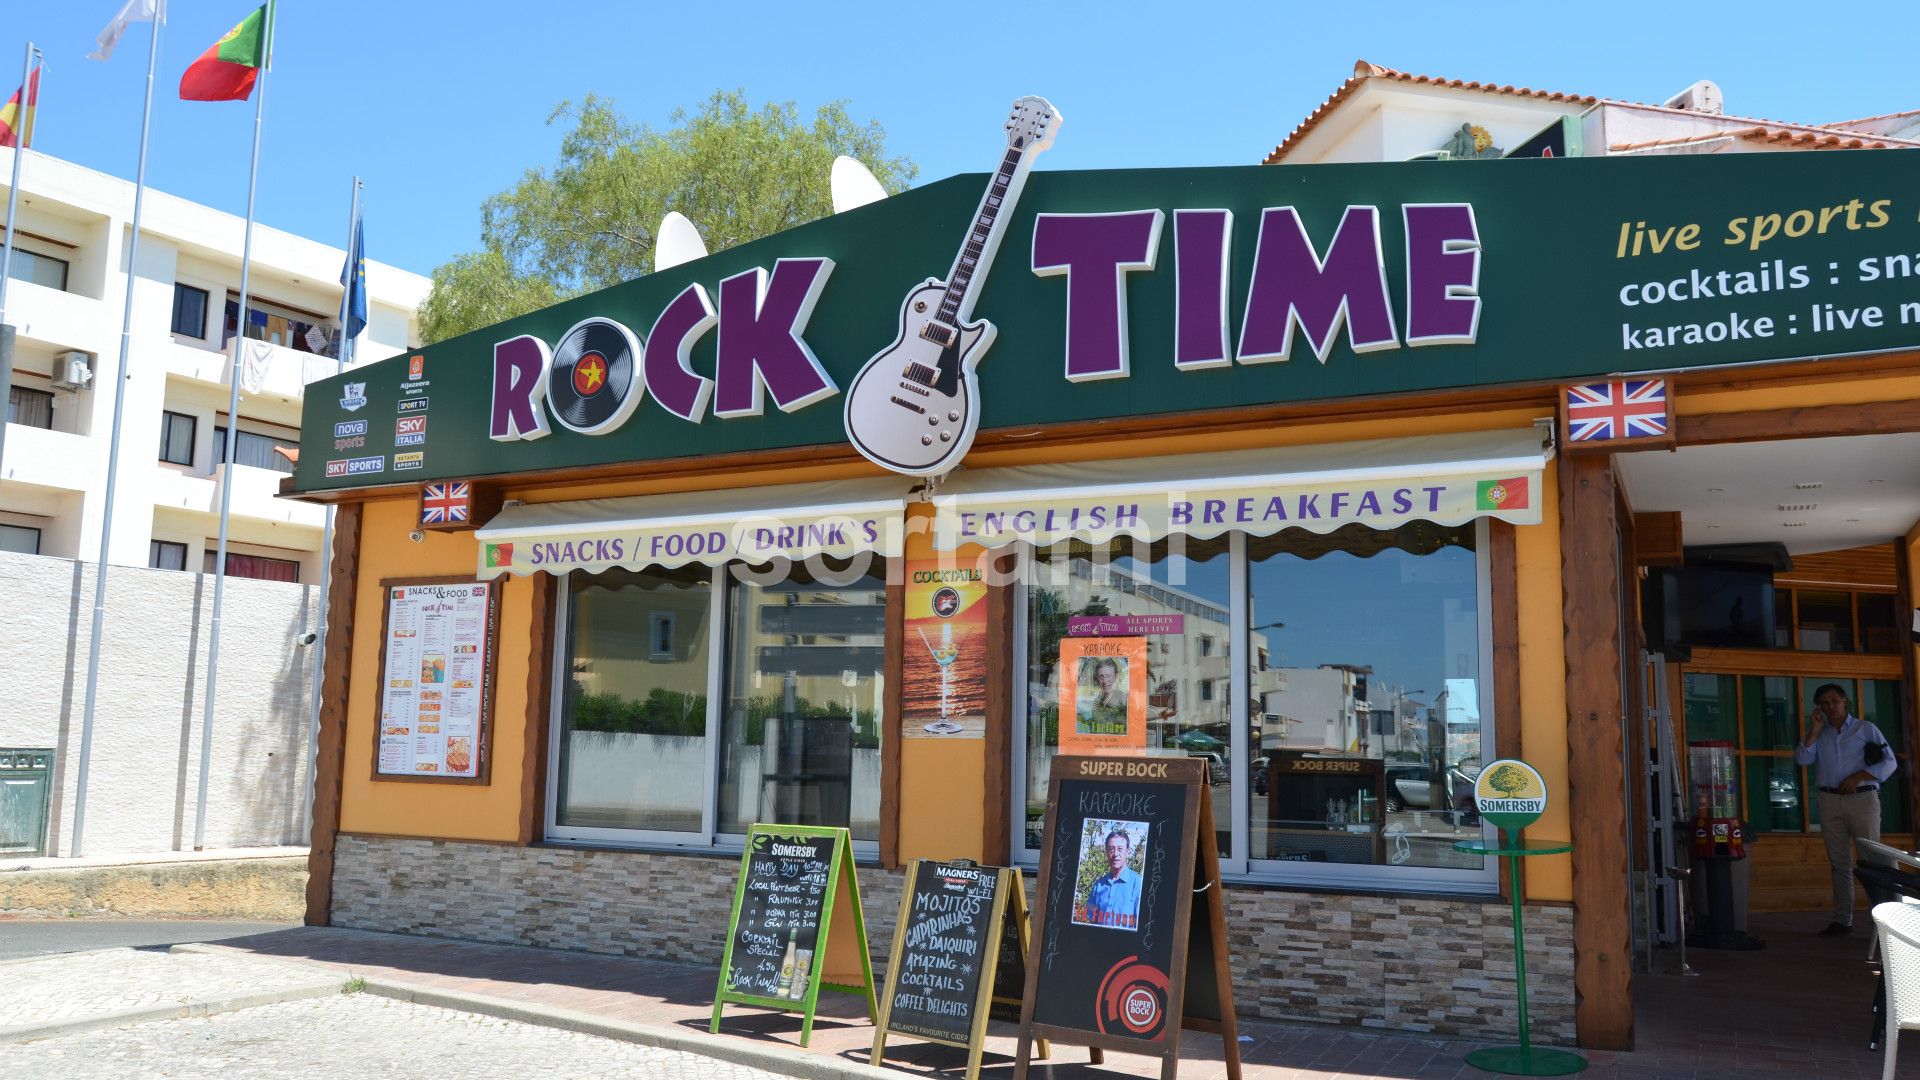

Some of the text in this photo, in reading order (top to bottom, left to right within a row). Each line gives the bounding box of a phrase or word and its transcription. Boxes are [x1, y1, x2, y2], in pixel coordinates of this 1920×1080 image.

[1616, 199, 1892, 258] live sports
[1619, 259, 1811, 306] cocktails
[1858, 250, 1920, 282] sn
[489, 203, 1482, 443] ROCK TIME
[1622, 312, 1775, 350] karaoke
[1812, 303, 1884, 332] live
[418, 400, 426, 408] TV
[338, 423, 364, 434] nova
[399, 418, 423, 432] SKY
[335, 436, 365, 451] sports
[397, 435, 423, 444] ITALIA
[328, 459, 382, 474] SKY SPORTS
[960, 485, 1447, 537] ENGLISH BREAKFAST
[530, 537, 625, 565] SNACKS
[650, 531, 727, 558] FOOD
[912, 567, 983, 584] COCKTAILS
[408, 586, 437, 596] SNACKS
[446, 588, 468, 598] FOOD
[1143, 616, 1173, 624] SPORTS
[1083, 643, 1123, 656] KARAOKE
[1079, 760, 1168, 778] SUPER BOCK
[1079, 791, 1160, 816] KARAOKE
[780, 860, 799, 877] DAY
[936, 866, 979, 880] MAGNERS
[978, 874, 996, 889] FREE
[916, 892, 981, 915] MOJITOS
[905, 909, 973, 947] CAIPIRINHAS
[929, 936, 977, 956] DAIQUIRI
[906, 953, 958, 972] AMAZING
[894, 993, 968, 1017] COFFEE DELIGHTS
[1130, 999, 1152, 1009] SUPER
[1130, 1006, 1150, 1016] BOCK
[919, 1026, 950, 1039] FAVOURITE
[950, 1032, 969, 1042] CIDER
